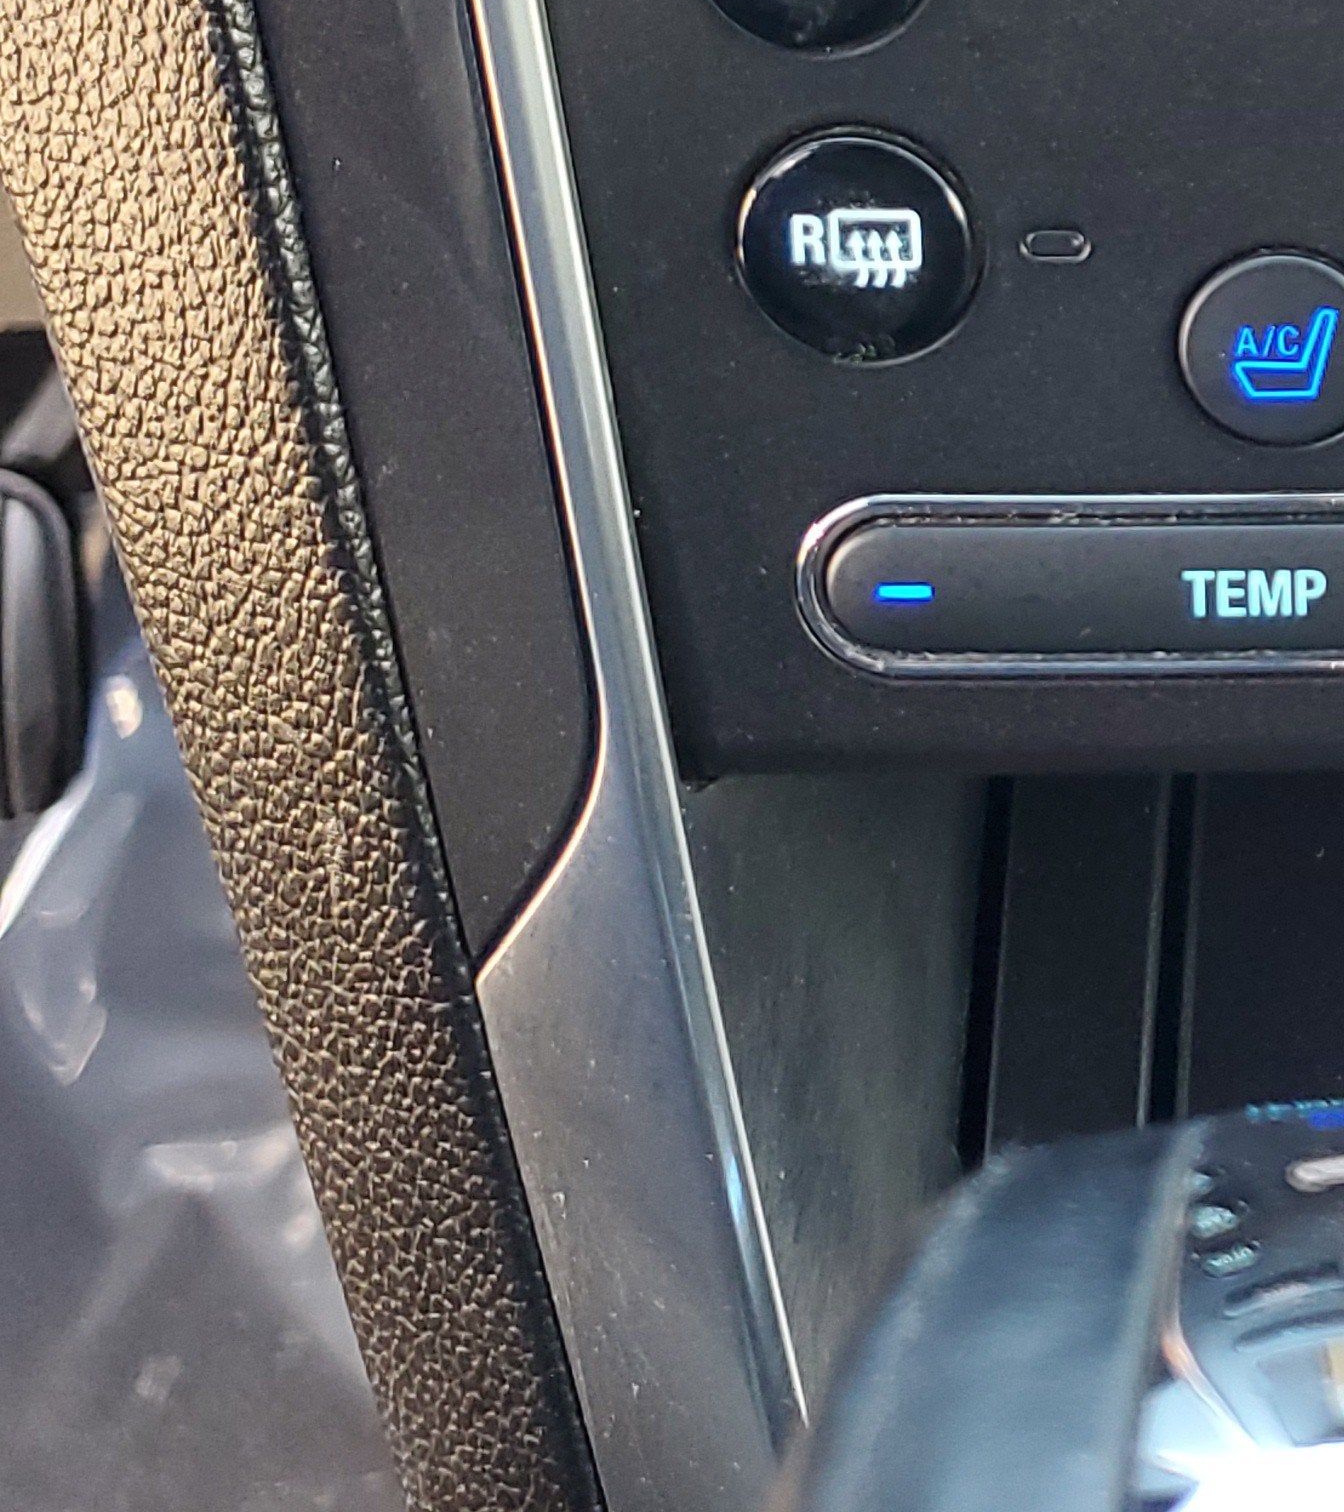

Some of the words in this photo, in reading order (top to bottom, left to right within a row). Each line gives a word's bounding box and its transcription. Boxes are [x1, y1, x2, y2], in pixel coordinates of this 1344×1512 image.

[789, 214, 826, 265] R
[1235, 324, 1300, 357] A/C
[1182, 567, 1327, 619] TEMP
